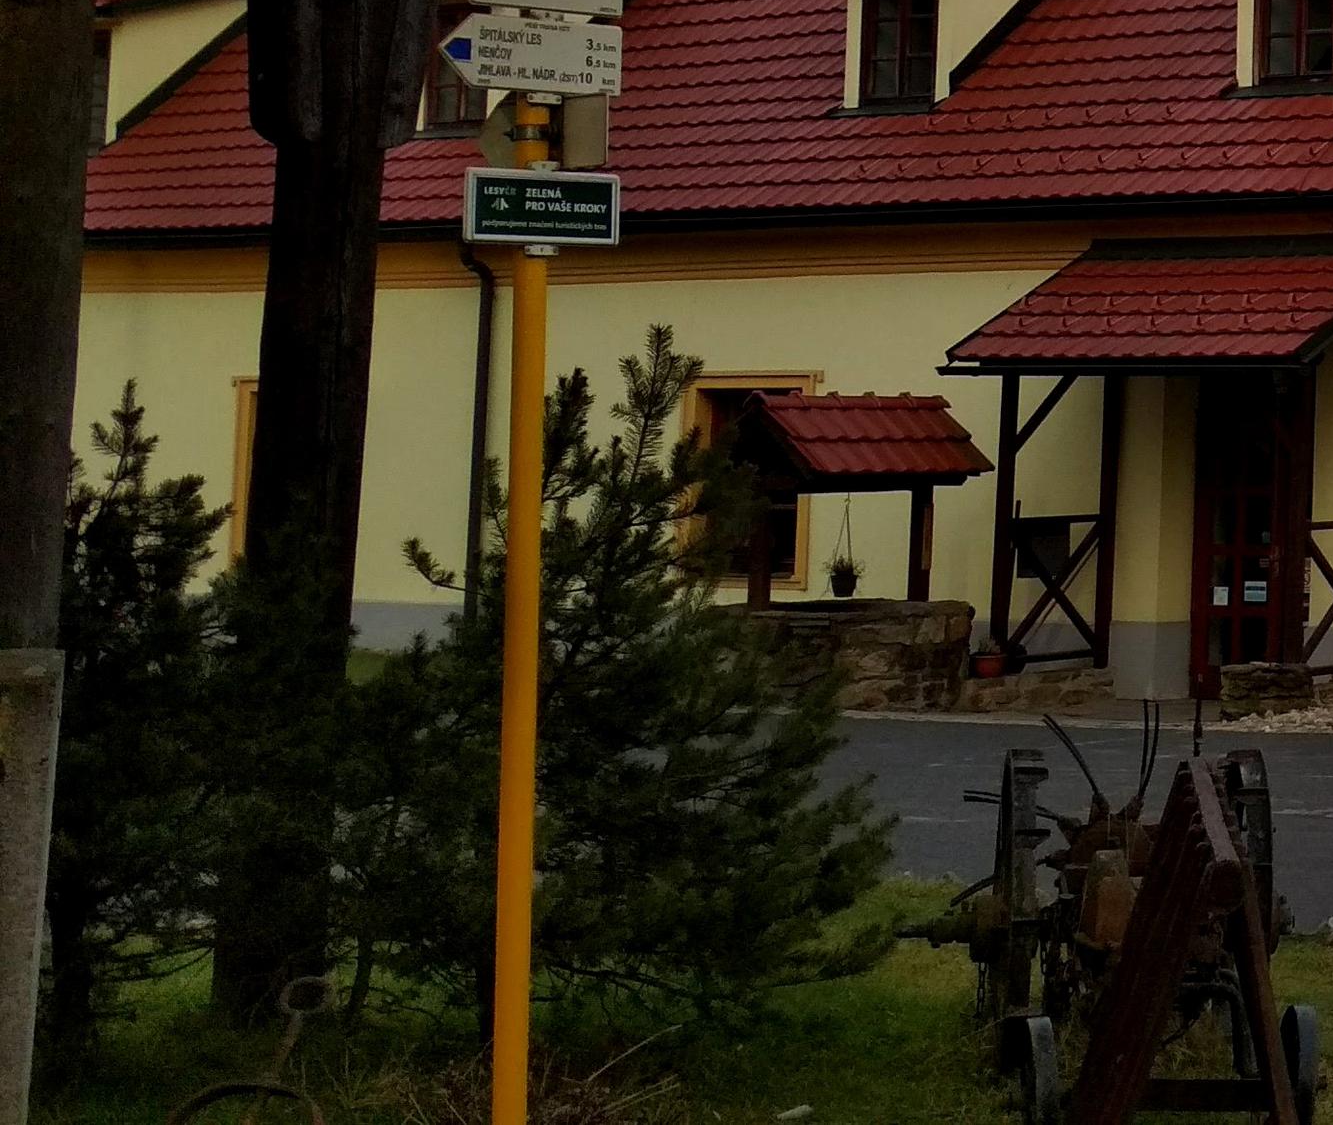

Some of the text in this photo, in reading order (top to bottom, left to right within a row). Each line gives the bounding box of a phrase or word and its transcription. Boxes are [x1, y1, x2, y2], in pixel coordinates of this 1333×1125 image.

[479, 25, 525, 44] ŠPITÁLSKÝ
[526, 33, 542, 45] LES
[478, 44, 513, 60] HENČOV
[603, 42, 617, 53] km
[478, 63, 512, 78] JIHLAVA
[603, 59, 616, 69] km
[579, 73, 616, 86] 10 km
[525, 186, 562, 199] ZELENÁ
[525, 200, 608, 214] PRO VAŠE KROKY
